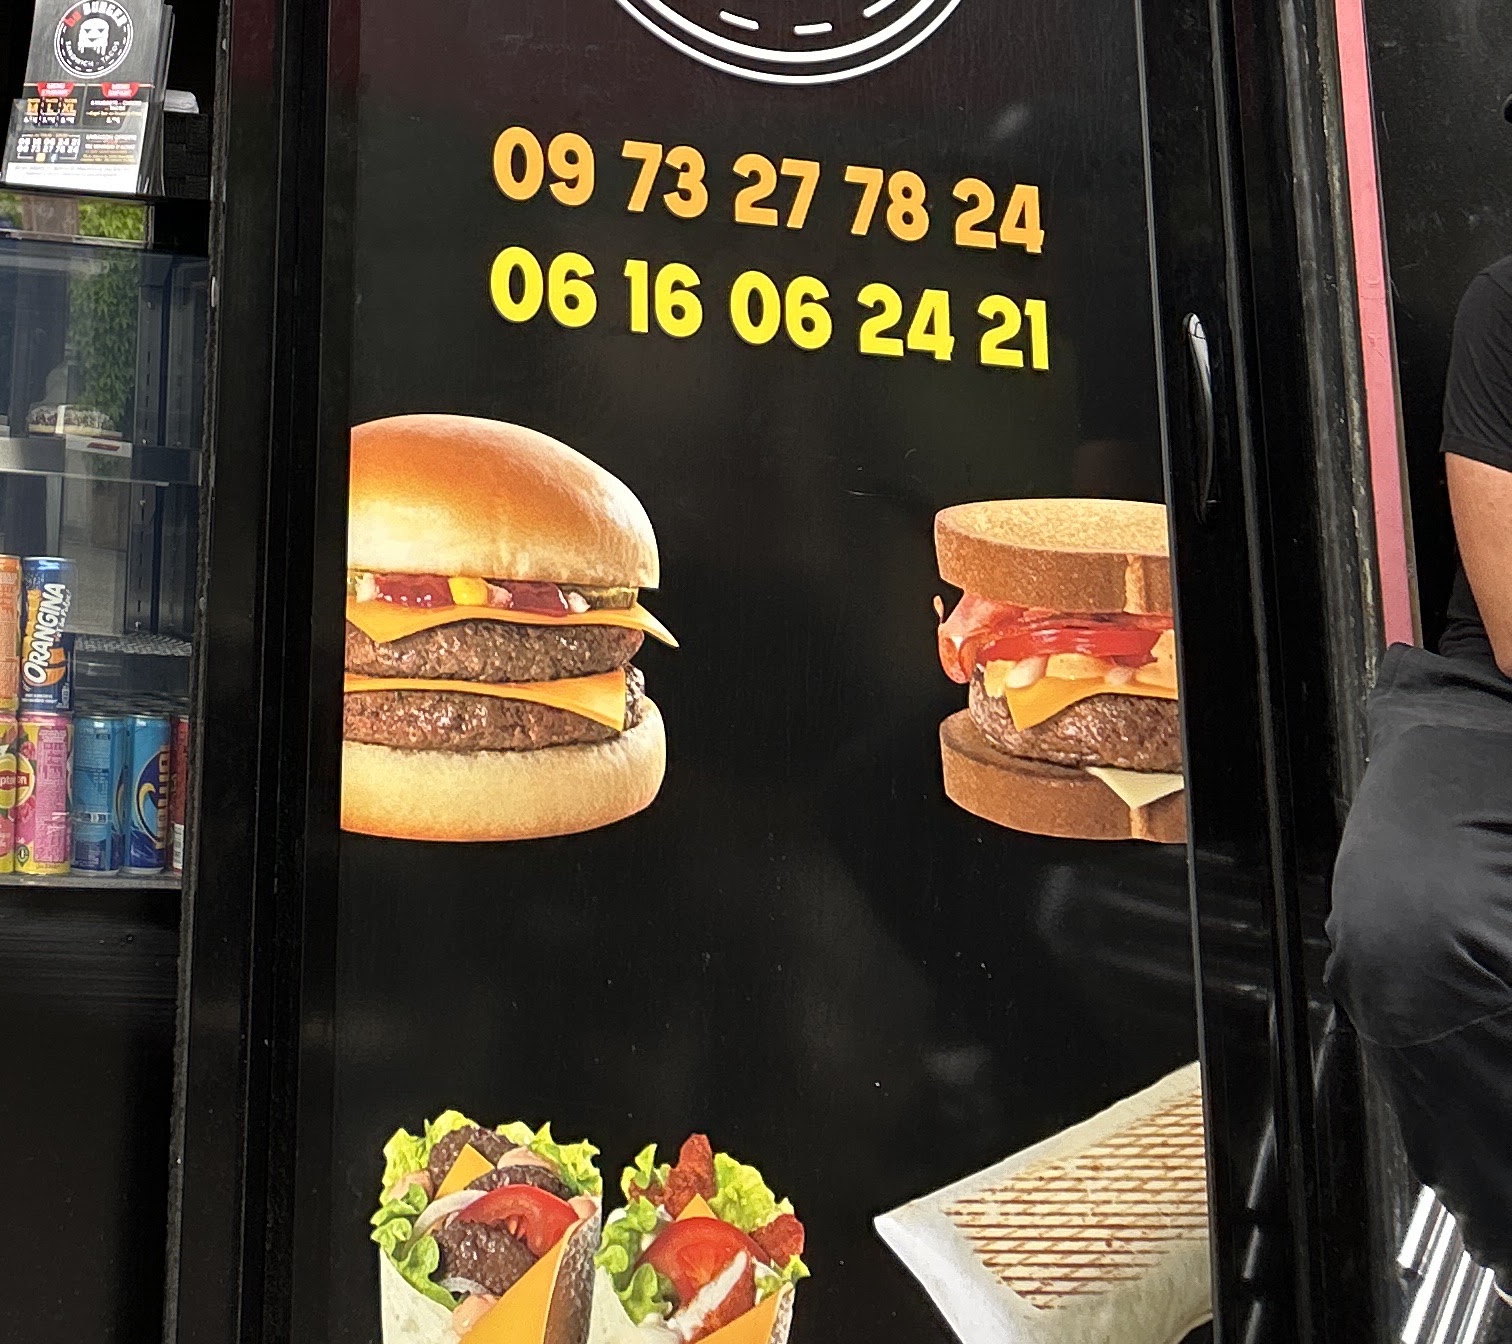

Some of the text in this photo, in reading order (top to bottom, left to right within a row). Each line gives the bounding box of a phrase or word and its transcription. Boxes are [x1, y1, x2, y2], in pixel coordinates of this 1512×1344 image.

[493, 125, 1045, 254] 09 73 27 78 24
[490, 245, 1050, 371] 06 16 06 24 21
[23, 582, 66, 684] ORANGINA
